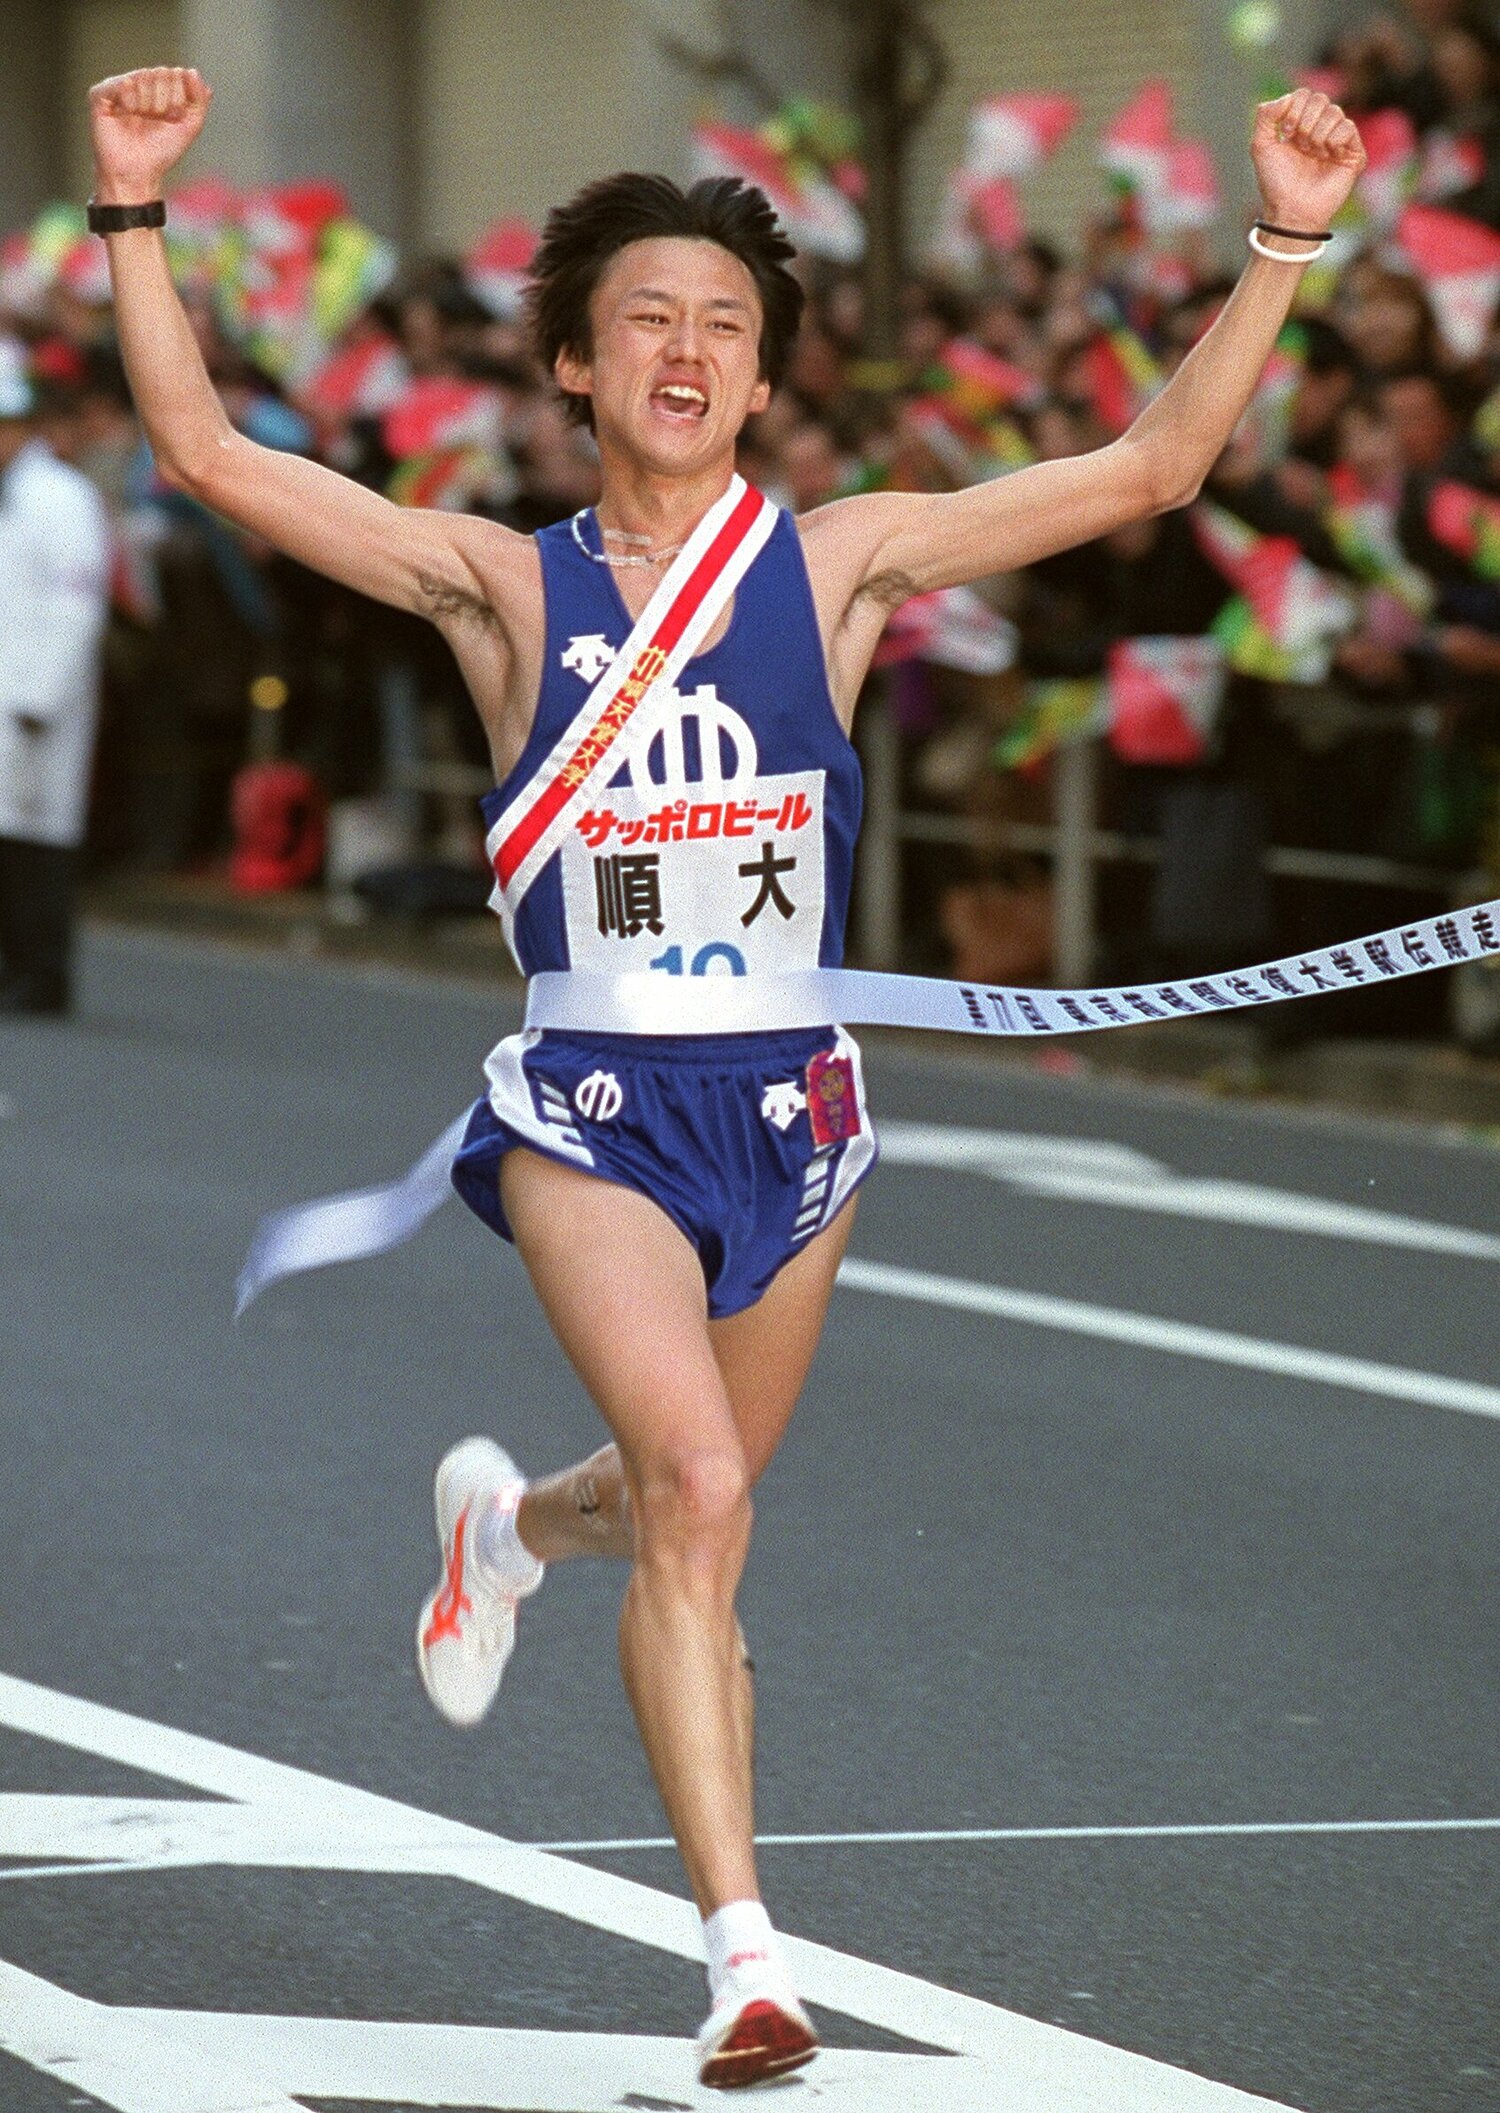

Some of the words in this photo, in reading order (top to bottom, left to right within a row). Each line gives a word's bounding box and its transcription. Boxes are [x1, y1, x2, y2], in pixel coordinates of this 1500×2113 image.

[575, 792, 813, 848] サッポロビール
